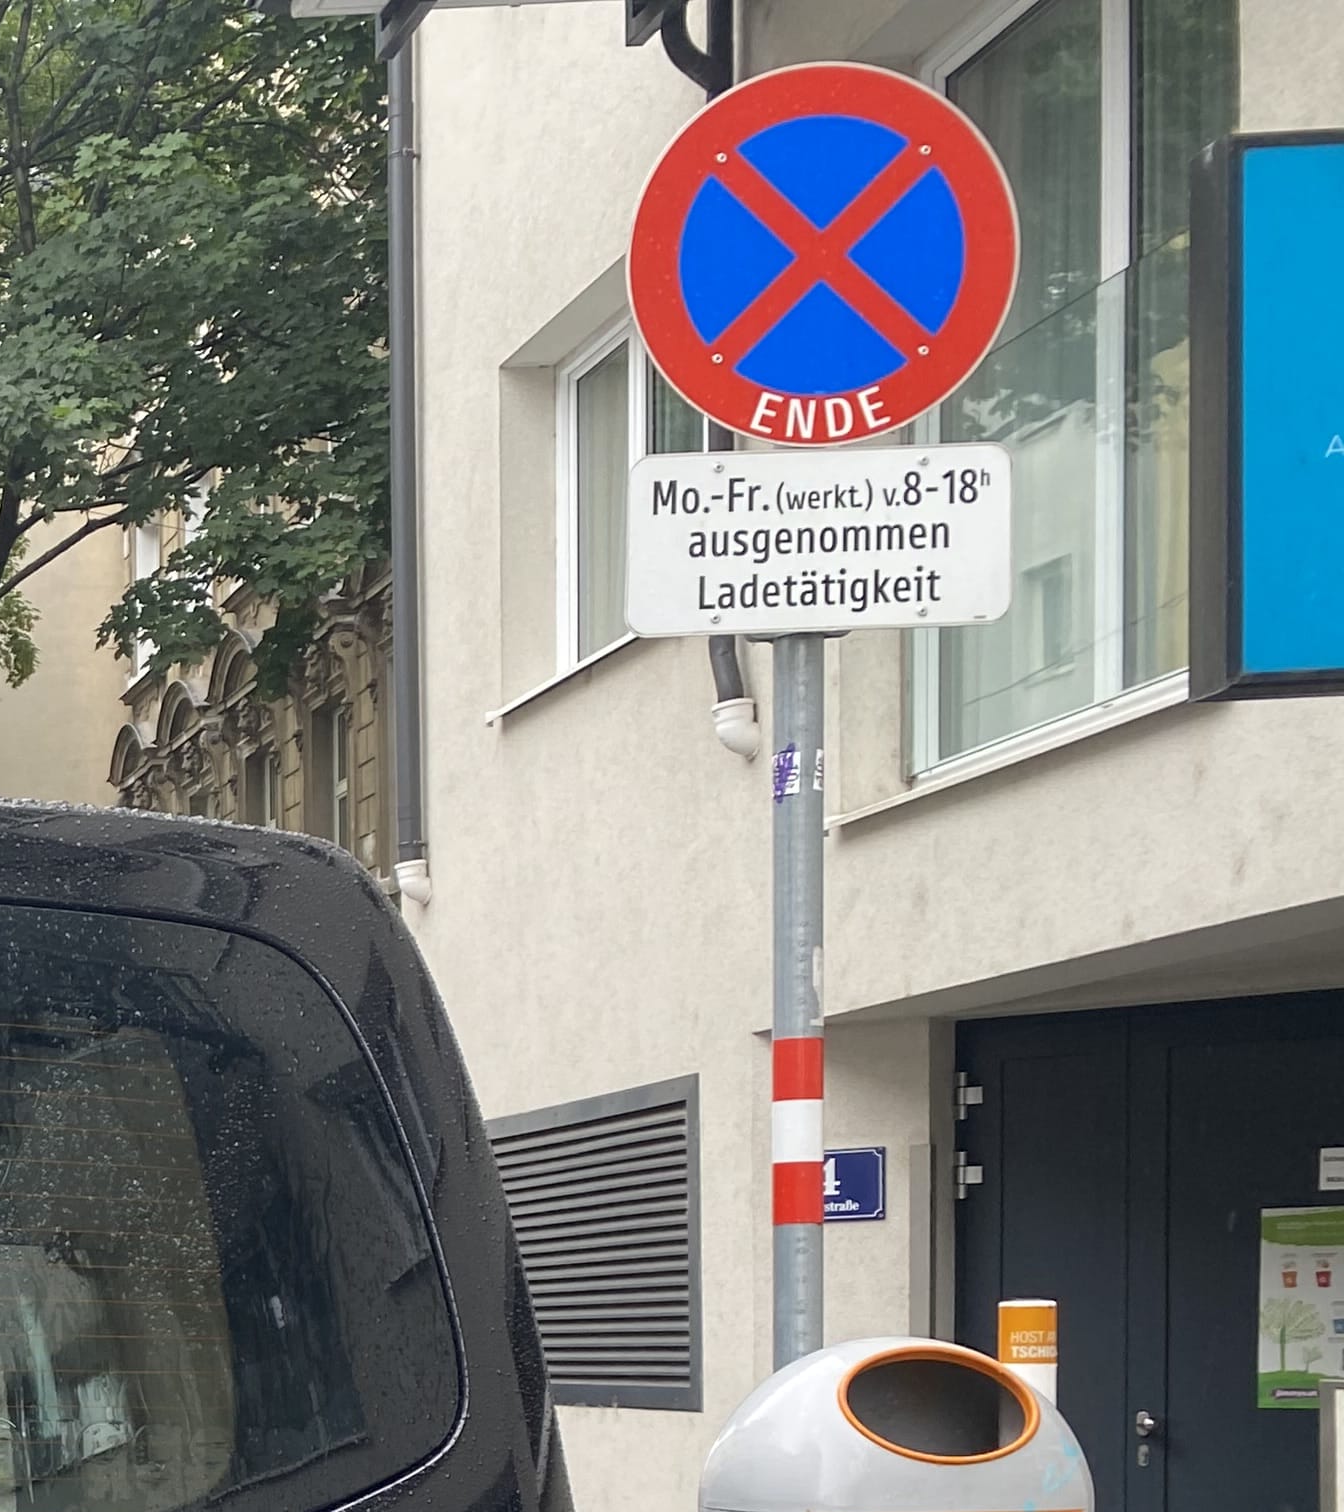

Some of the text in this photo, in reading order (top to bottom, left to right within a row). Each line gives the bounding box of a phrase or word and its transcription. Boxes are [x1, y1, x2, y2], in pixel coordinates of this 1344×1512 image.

[750, 386, 891, 439] ENDE
[689, 521, 950, 564] ausgenommen
[698, 566, 941, 612] Ladetätigkeit
[1010, 1330, 1044, 1344] HOST
